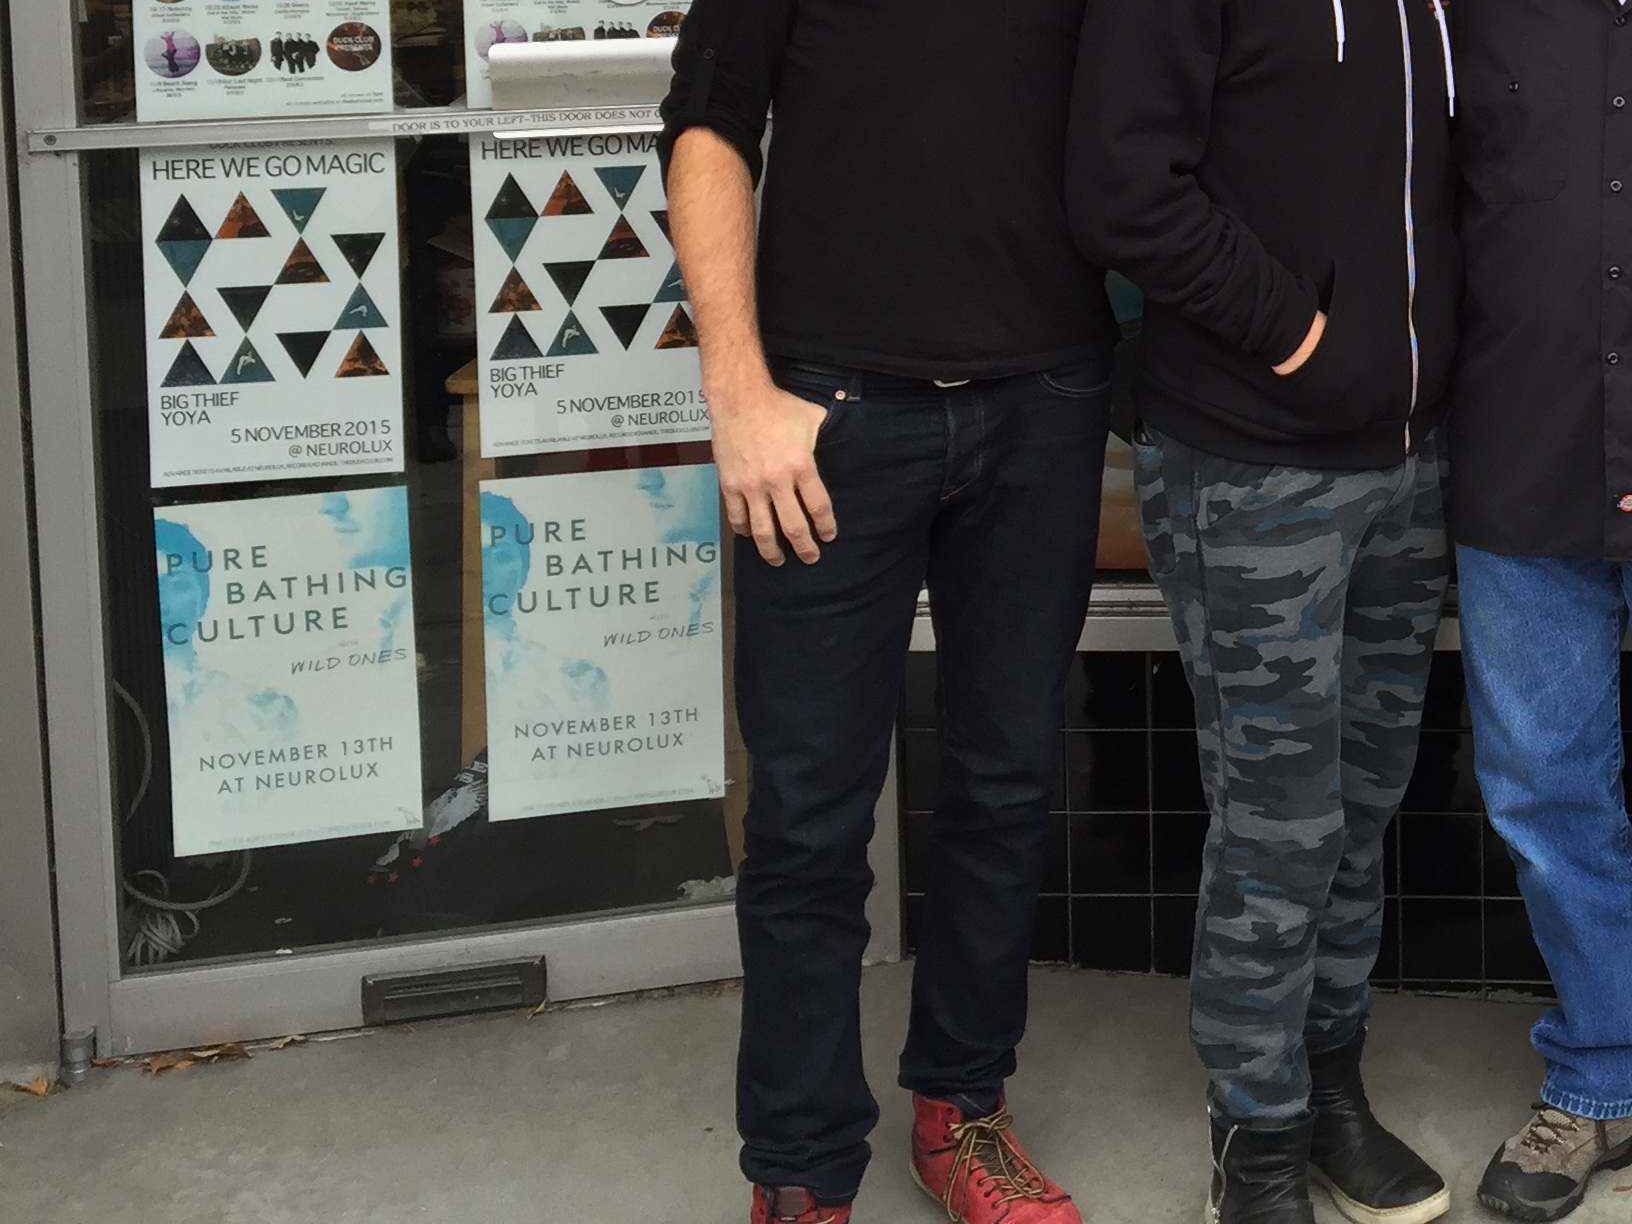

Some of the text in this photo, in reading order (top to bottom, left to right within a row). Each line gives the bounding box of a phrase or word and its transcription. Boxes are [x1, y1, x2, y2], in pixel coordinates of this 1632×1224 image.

[392, 121, 427, 132] DOOR
[429, 121, 441, 131] IS
[445, 120, 460, 129] TO
[462, 117, 495, 128] YOUR
[559, 111, 592, 122] DOOR
[595, 110, 627, 120] DOES
[629, 110, 652, 119] NOT
[481, 134, 658, 160] HERE WE GO MA
[152, 152, 386, 181] HERE WE GO MAGIC
[490, 364, 565, 382] BIG THIEF
[161, 391, 240, 410] BIG THIEF
[491, 382, 538, 398] YOYA
[557, 390, 707, 414] 5 NOVEMBER 2015
[161, 410, 211, 426] YOYA
[231, 420, 391, 443] 5 NOVEMBER 2015
[611, 408, 709, 428] @ NEUROLUX
[289, 439, 393, 458] @ NEUROLUX
[491, 518, 587, 547] PURE
[167, 545, 268, 575] PURE
[545, 541, 717, 576] BATHING
[226, 566, 408, 604] BATHING
[488, 581, 660, 616] CULTURE
[166, 607, 349, 645] CULTURE
[603, 621, 715, 648] WILD ONES
[290, 648, 408, 675] WILD ONES
[514, 707, 698, 739] NOVEMBER 13TH
[200, 736, 394, 772] NOVEMBER 13TH
[531, 732, 684, 762] AT NEUROLUX
[217, 762, 379, 795] AT NEUROLUX
